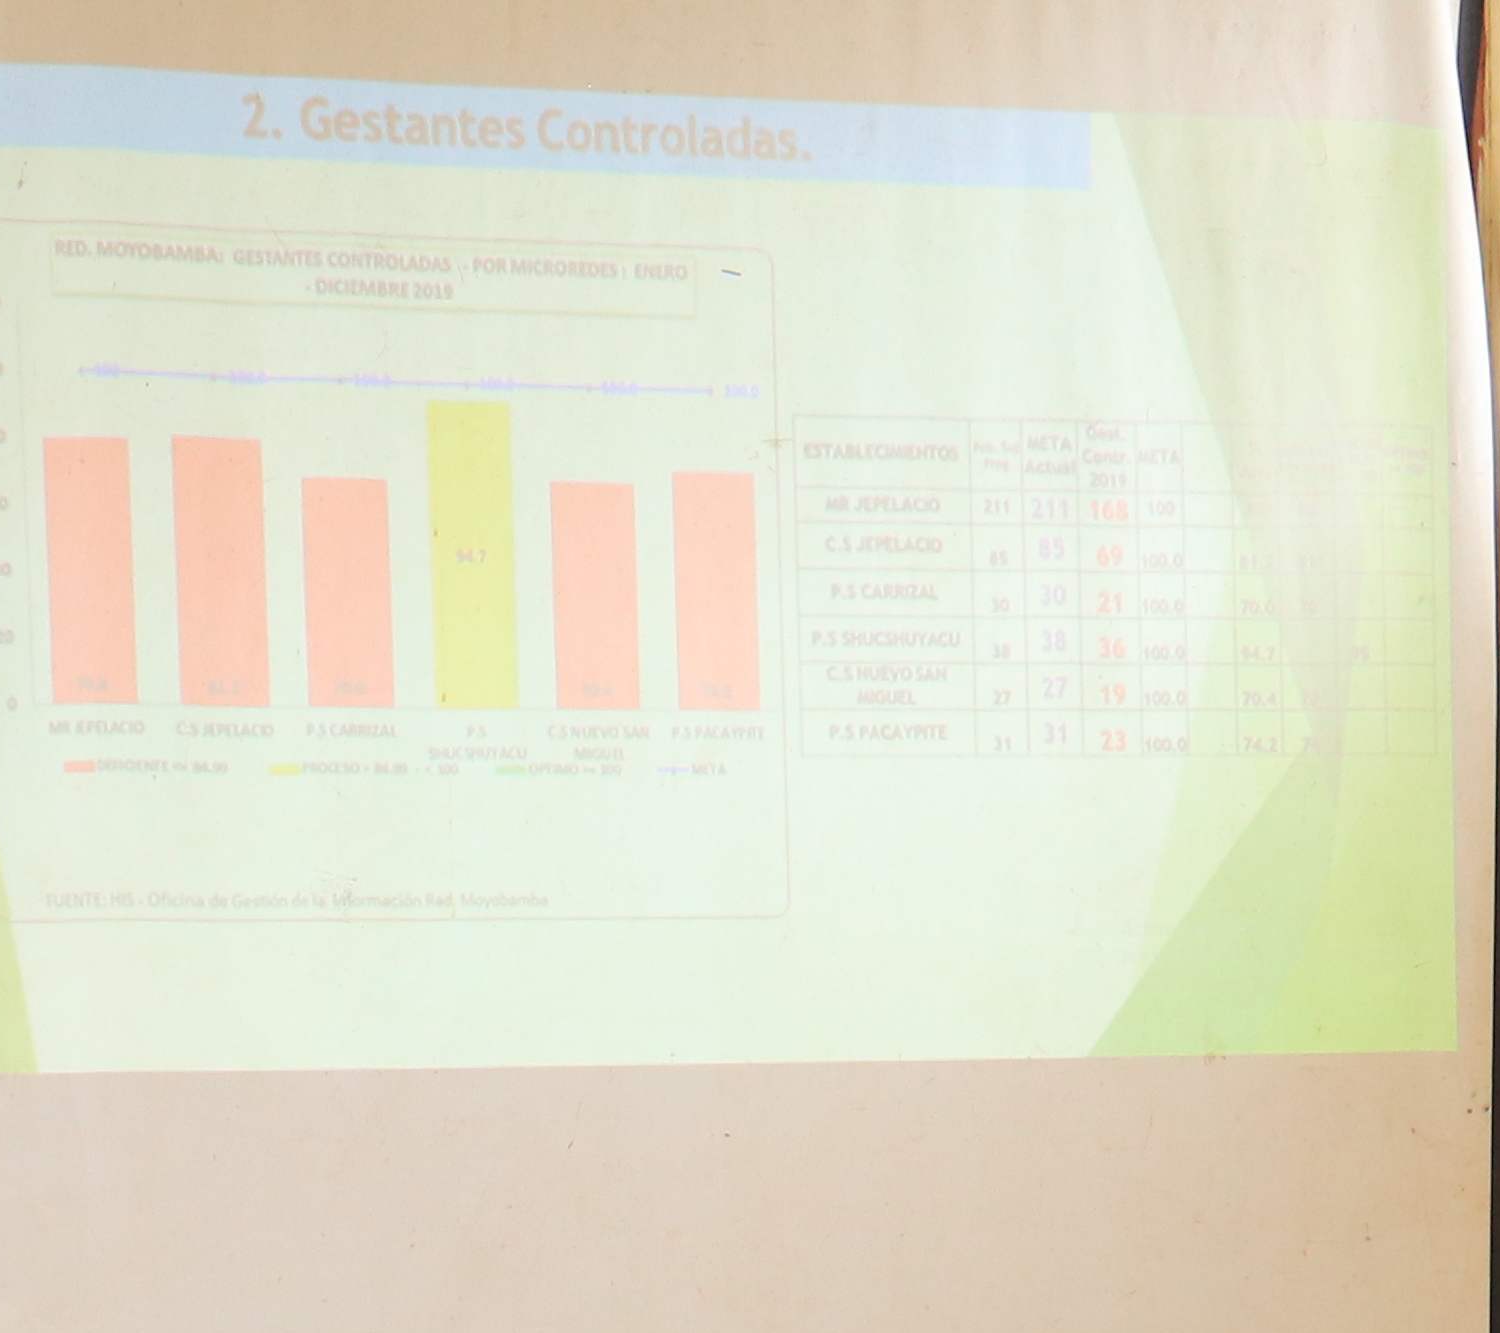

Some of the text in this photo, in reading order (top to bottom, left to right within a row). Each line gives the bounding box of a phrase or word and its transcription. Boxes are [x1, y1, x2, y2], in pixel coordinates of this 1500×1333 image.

[241, 93, 813, 162] 2. Gestantes Controladas.
[55, 239, 687, 281] RED. MOYOBAMBA: GESTANTES CONTROLADAS POR MICROREDES ENERO
[315, 277, 453, 299] DICIEMBRE 2019
[1027, 436, 1072, 450] META
[804, 443, 959, 461] ESTABLECIMIENTOS
[1138, 450, 1179, 464] META
[1026, 459, 1077, 474] Actual
[1090, 473, 1127, 488] 2019
[825, 496, 941, 513] MR JEPELACIO
[983, 499, 1010, 515] 211
[1031, 499, 1070, 519] 211
[1089, 500, 1129, 520] 168
[1148, 501, 1175, 515] 100
[825, 536, 942, 553] C.S JEPELACIO
[1038, 536, 1065, 559] 85
[990, 551, 1008, 566] 85
[1096, 545, 1123, 566] 69
[1142, 555, 1184, 568] 100.0
[831, 582, 938, 601] P.S CARRIZAL
[1041, 584, 1066, 606] 30
[991, 598, 1010, 613] 30
[1097, 591, 1123, 613] 21
[1142, 600, 1185, 614] 100.0
[1241, 600, 1275, 614] 70.0
[811, 631, 961, 647] P.S SHUCSHUYACU
[1041, 630, 1067, 652] 38
[1099, 636, 1126, 659] 36
[1143, 645, 1187, 660] 100.0
[1241, 645, 1277, 660] 94.7
[827, 666, 948, 682] C.S NUEVO SAN
[1042, 676, 1068, 699] 27
[1100, 683, 1126, 704] 19
[6, 696, 18, 712] 0
[857, 690, 916, 705] MIGUEL
[993, 690, 1011, 705] 27
[1144, 691, 1188, 706] 100.0
[1243, 691, 1277, 706] 70.4
[306, 723, 398, 739] P.S CARRIZAL
[467, 725, 487, 738] P.S
[548, 726, 650, 739] C.S NUEVO SAN
[829, 724, 948, 740] P.S PACAYPITE
[1043, 722, 1068, 744] 31
[994, 736, 1011, 751] 31
[1100, 730, 1127, 751] 23
[1145, 738, 1189, 752] 100.0
[1243, 738, 1278, 753] 74.2
[574, 747, 625, 761] MIGUEL
[692, 764, 727, 775] META
[148, 892, 205, 908] Oficina
[209, 893, 228, 908] de
[232, 892, 288, 909] Gestión
[292, 892, 309, 908] de
[312, 892, 326, 908] la
[461, 892, 548, 910] Moyobamba
